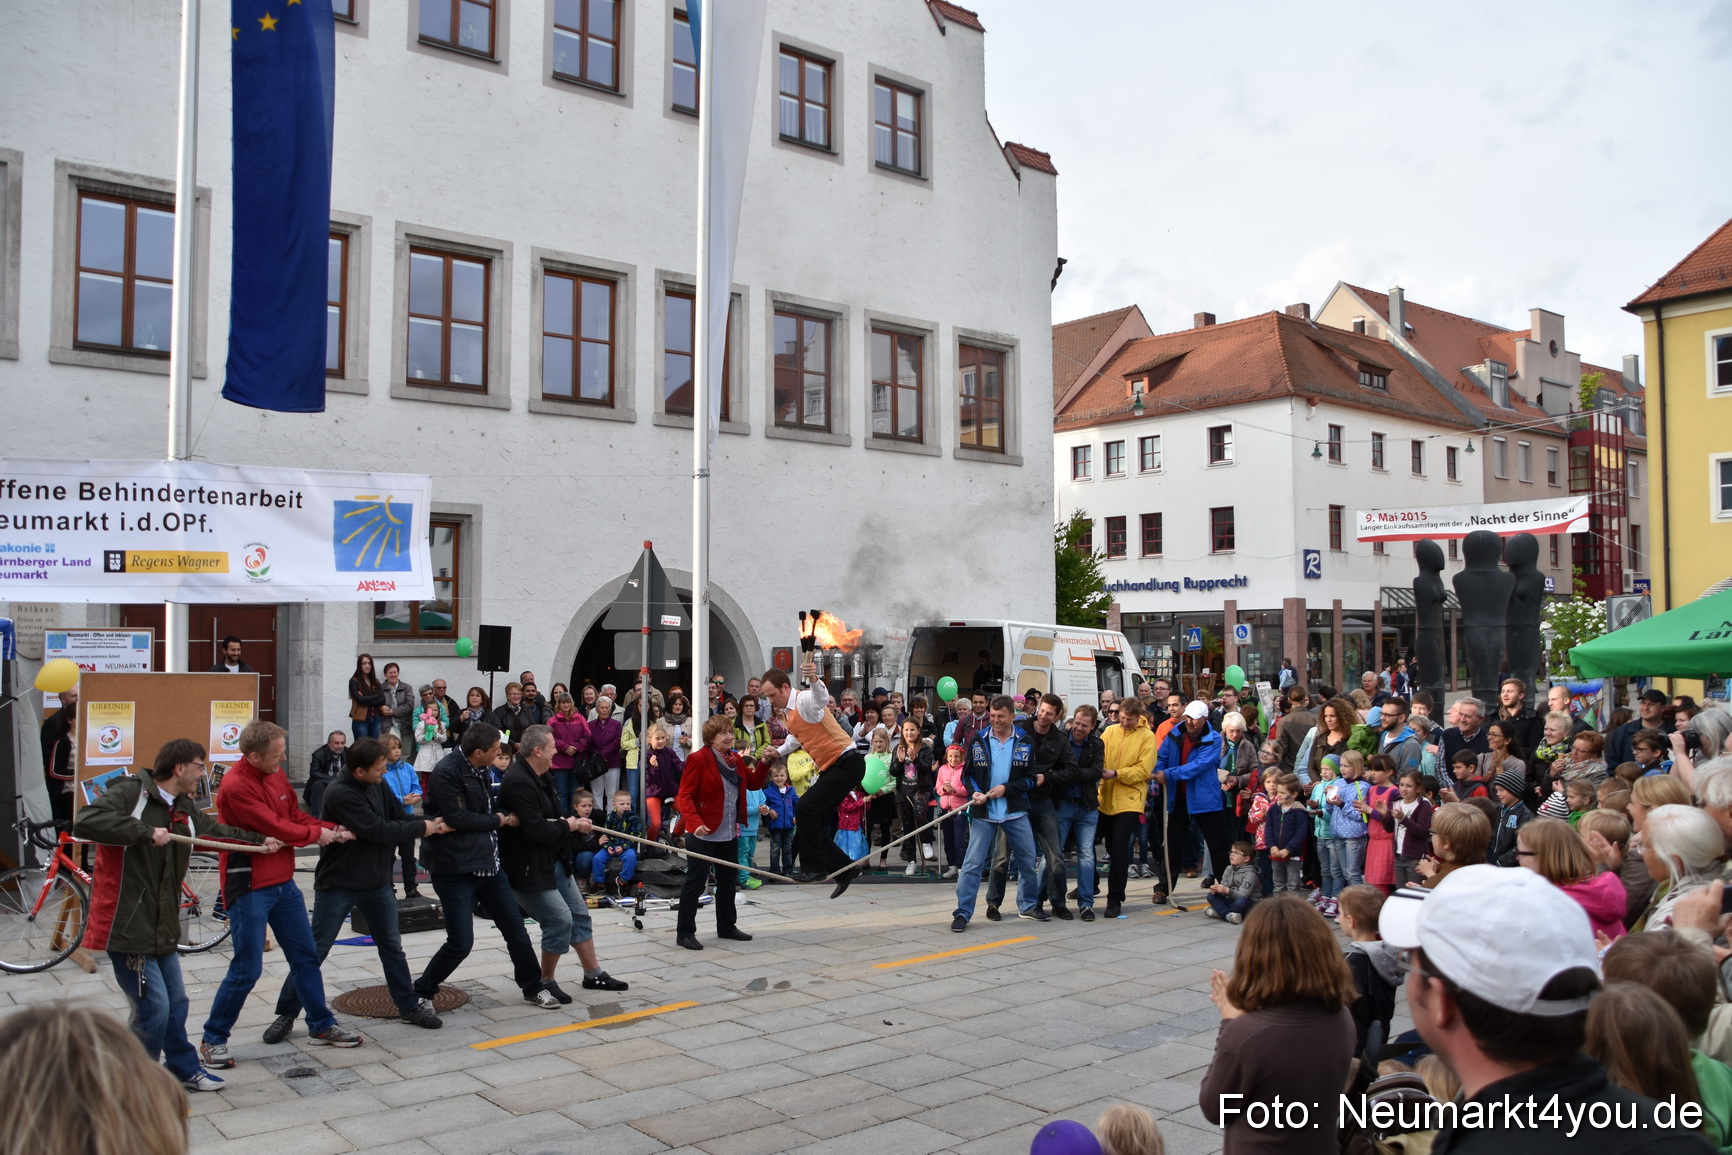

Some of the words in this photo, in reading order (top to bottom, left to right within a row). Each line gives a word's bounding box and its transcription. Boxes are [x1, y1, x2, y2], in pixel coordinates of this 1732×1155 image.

[0, 479, 67, 501] ffene
[79, 481, 303, 509] Behindertenarbeit
[0, 511, 109, 531] eumarkt
[1365, 513, 1376, 523] 9.
[1378, 512, 1398, 522] Mai
[1400, 511, 1428, 521] 2015
[1383, 522, 1438, 530] Einkaufssamstag
[1509, 512, 1530, 523] der
[62, 556, 92, 567] Land
[131, 554, 174, 571] Regens
[177, 554, 221, 571] Wagner
[1306, 552, 1321, 575] R
[1102, 577, 1180, 593] uchhandlung
[1184, 574, 1248, 591] Rupprecht
